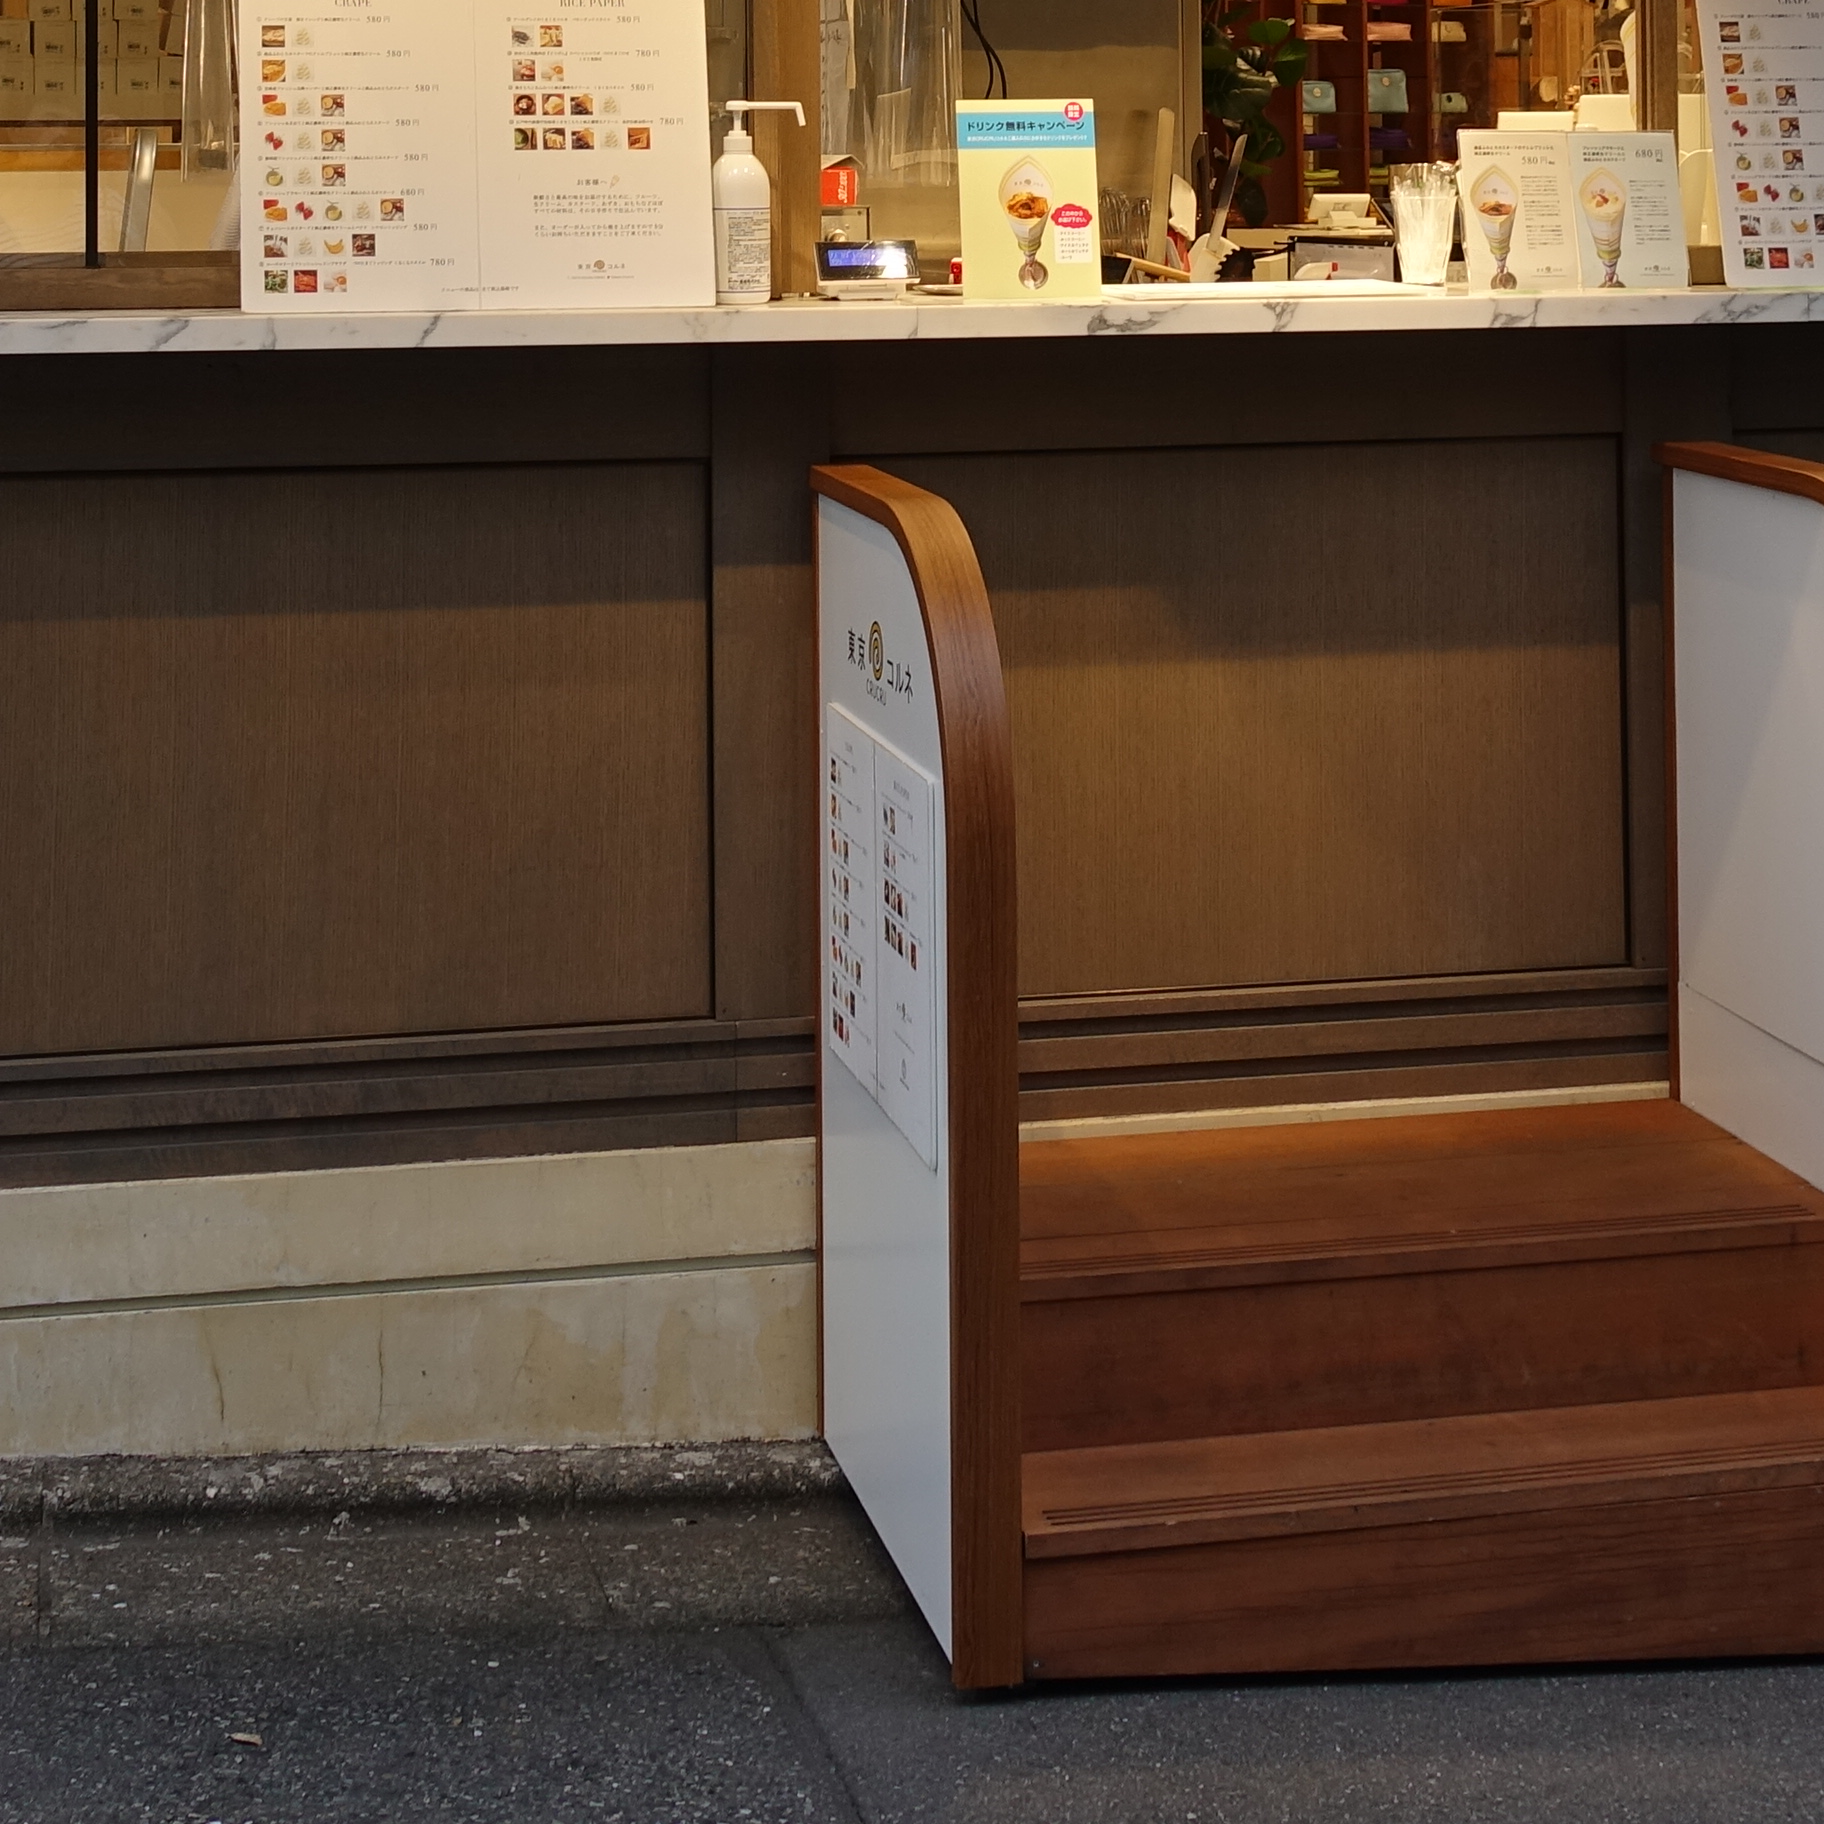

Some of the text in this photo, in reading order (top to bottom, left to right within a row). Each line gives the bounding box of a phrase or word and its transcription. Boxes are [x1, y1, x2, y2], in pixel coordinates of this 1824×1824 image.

[967, 121, 1085, 132] ドリンク無料キャンペーン
[576, 177, 608, 186] お客様へ
[847, 628, 914, 704] 東京 コルネ
[866, 678, 887, 707] CRUCRU
